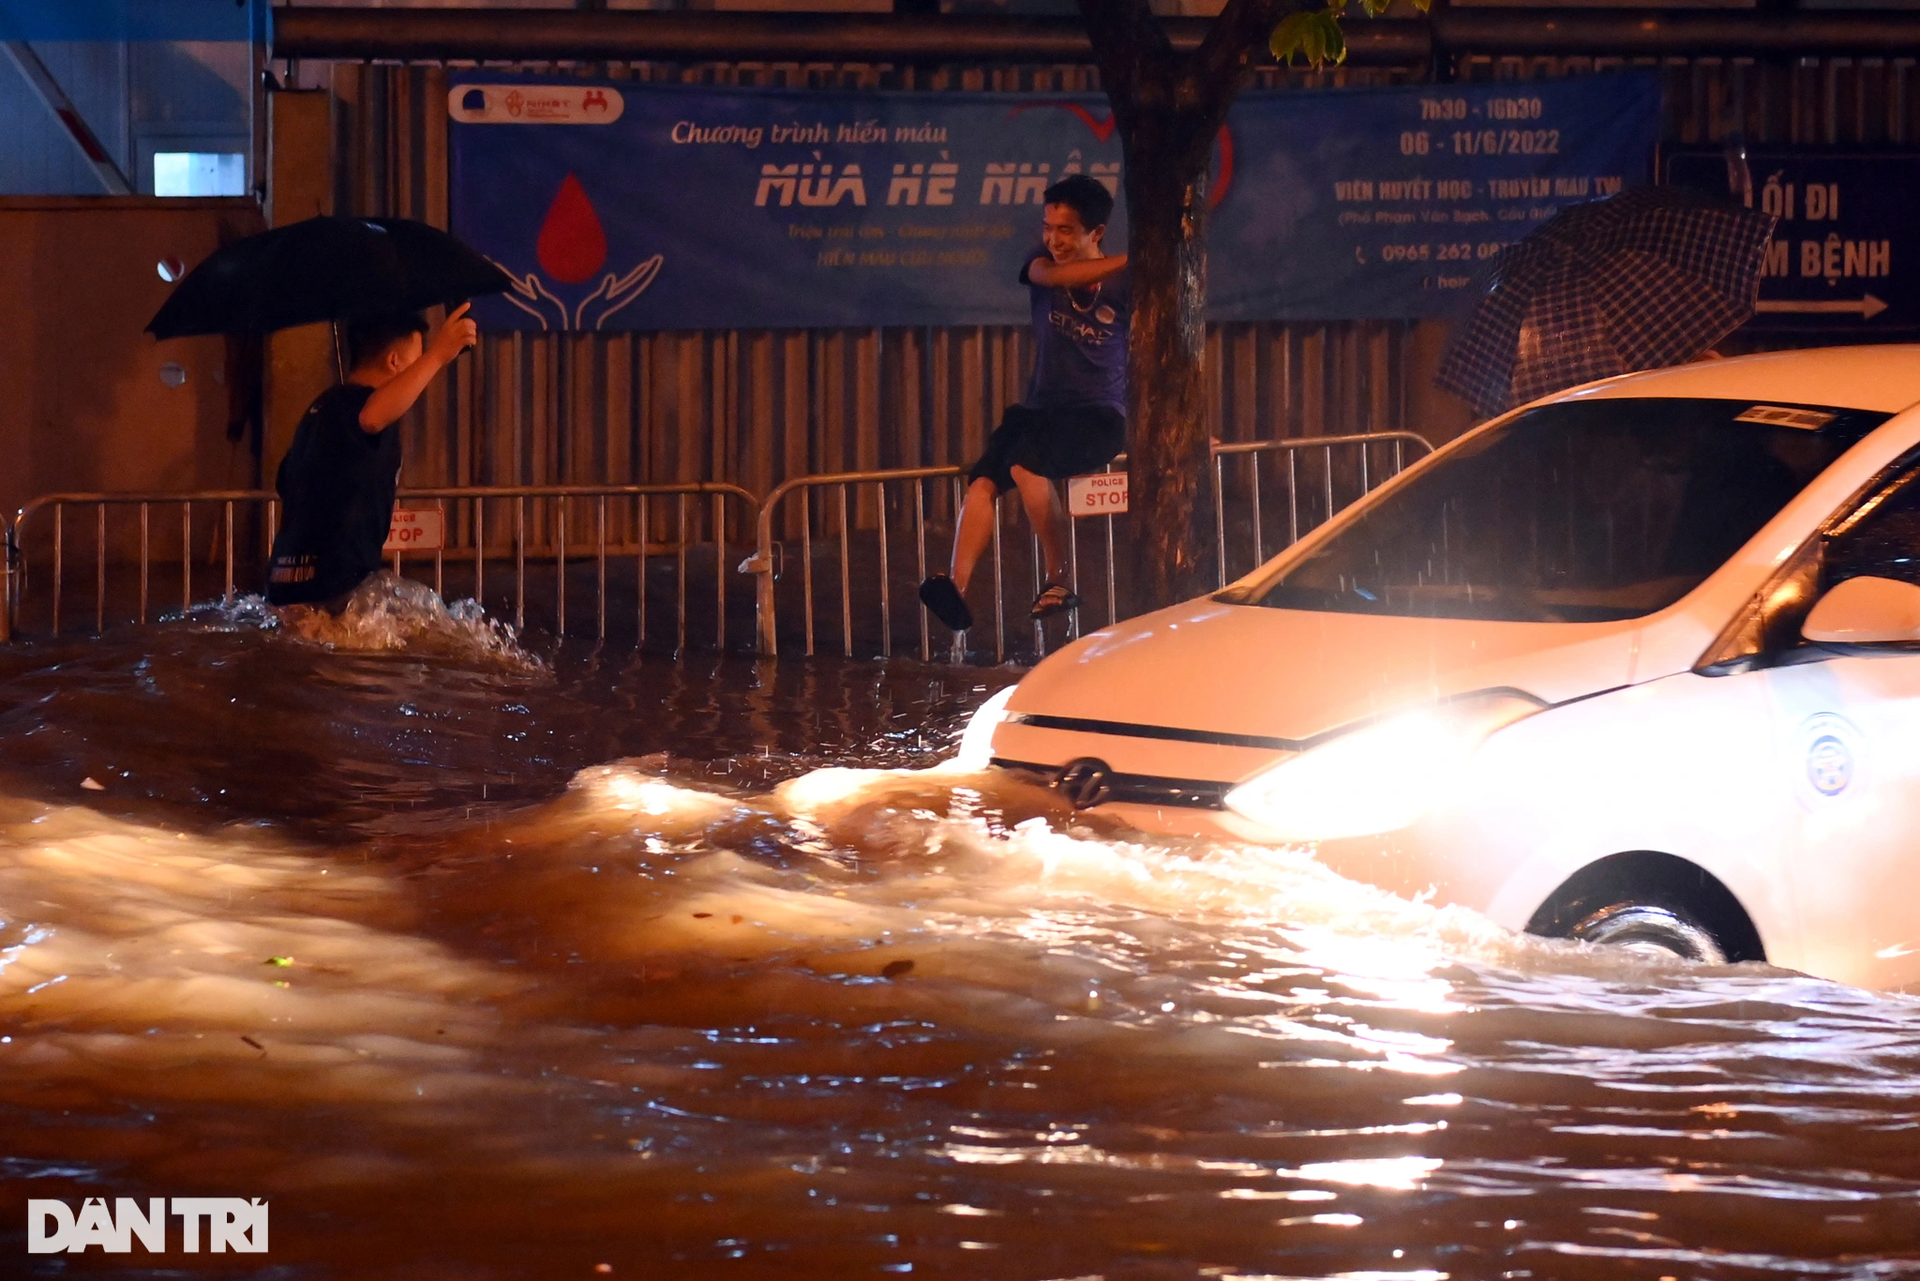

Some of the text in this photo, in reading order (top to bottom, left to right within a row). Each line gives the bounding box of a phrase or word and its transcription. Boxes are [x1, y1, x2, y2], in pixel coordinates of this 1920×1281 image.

[1420, 98, 1467, 121] 7h30
[671, 119, 947, 149] Chương trình hiến máu
[1400, 131, 1430, 155] 06
[1452, 129, 1560, 156] 11/6/2022
[754, 150, 867, 207] MÙA
[886, 150, 959, 207] HÈ
[1805, 183, 1839, 221] ĐI
[1436, 243, 1471, 261] 262
[1801, 232, 1890, 287] BỆNH
[1091, 478, 1124, 487] POLICE
[388, 527, 424, 543] TOP
